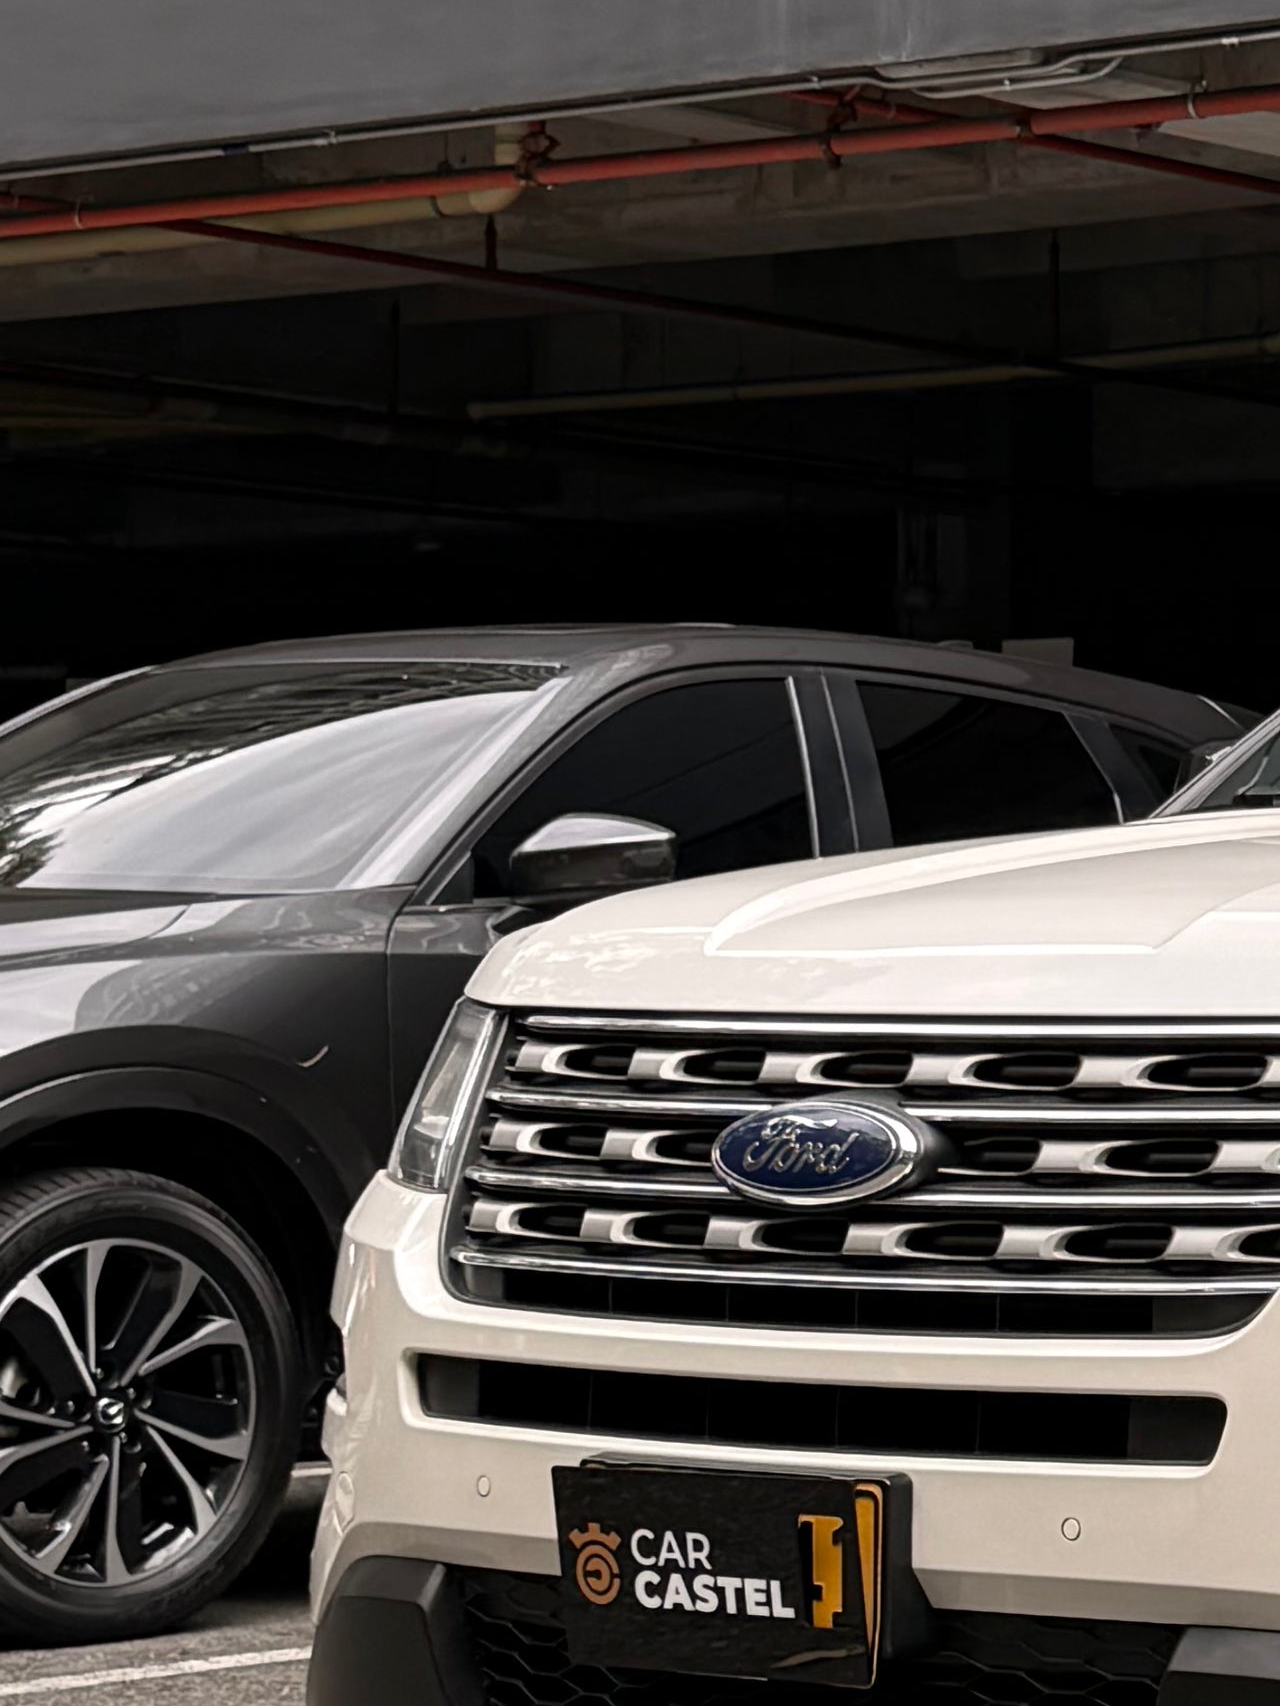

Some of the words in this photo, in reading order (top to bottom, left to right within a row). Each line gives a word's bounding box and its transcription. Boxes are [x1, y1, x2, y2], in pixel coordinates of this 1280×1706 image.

[742, 1114, 860, 1174] Ford
[630, 1528, 711, 1570] CAR
[634, 1570, 795, 1619] CASTEL
